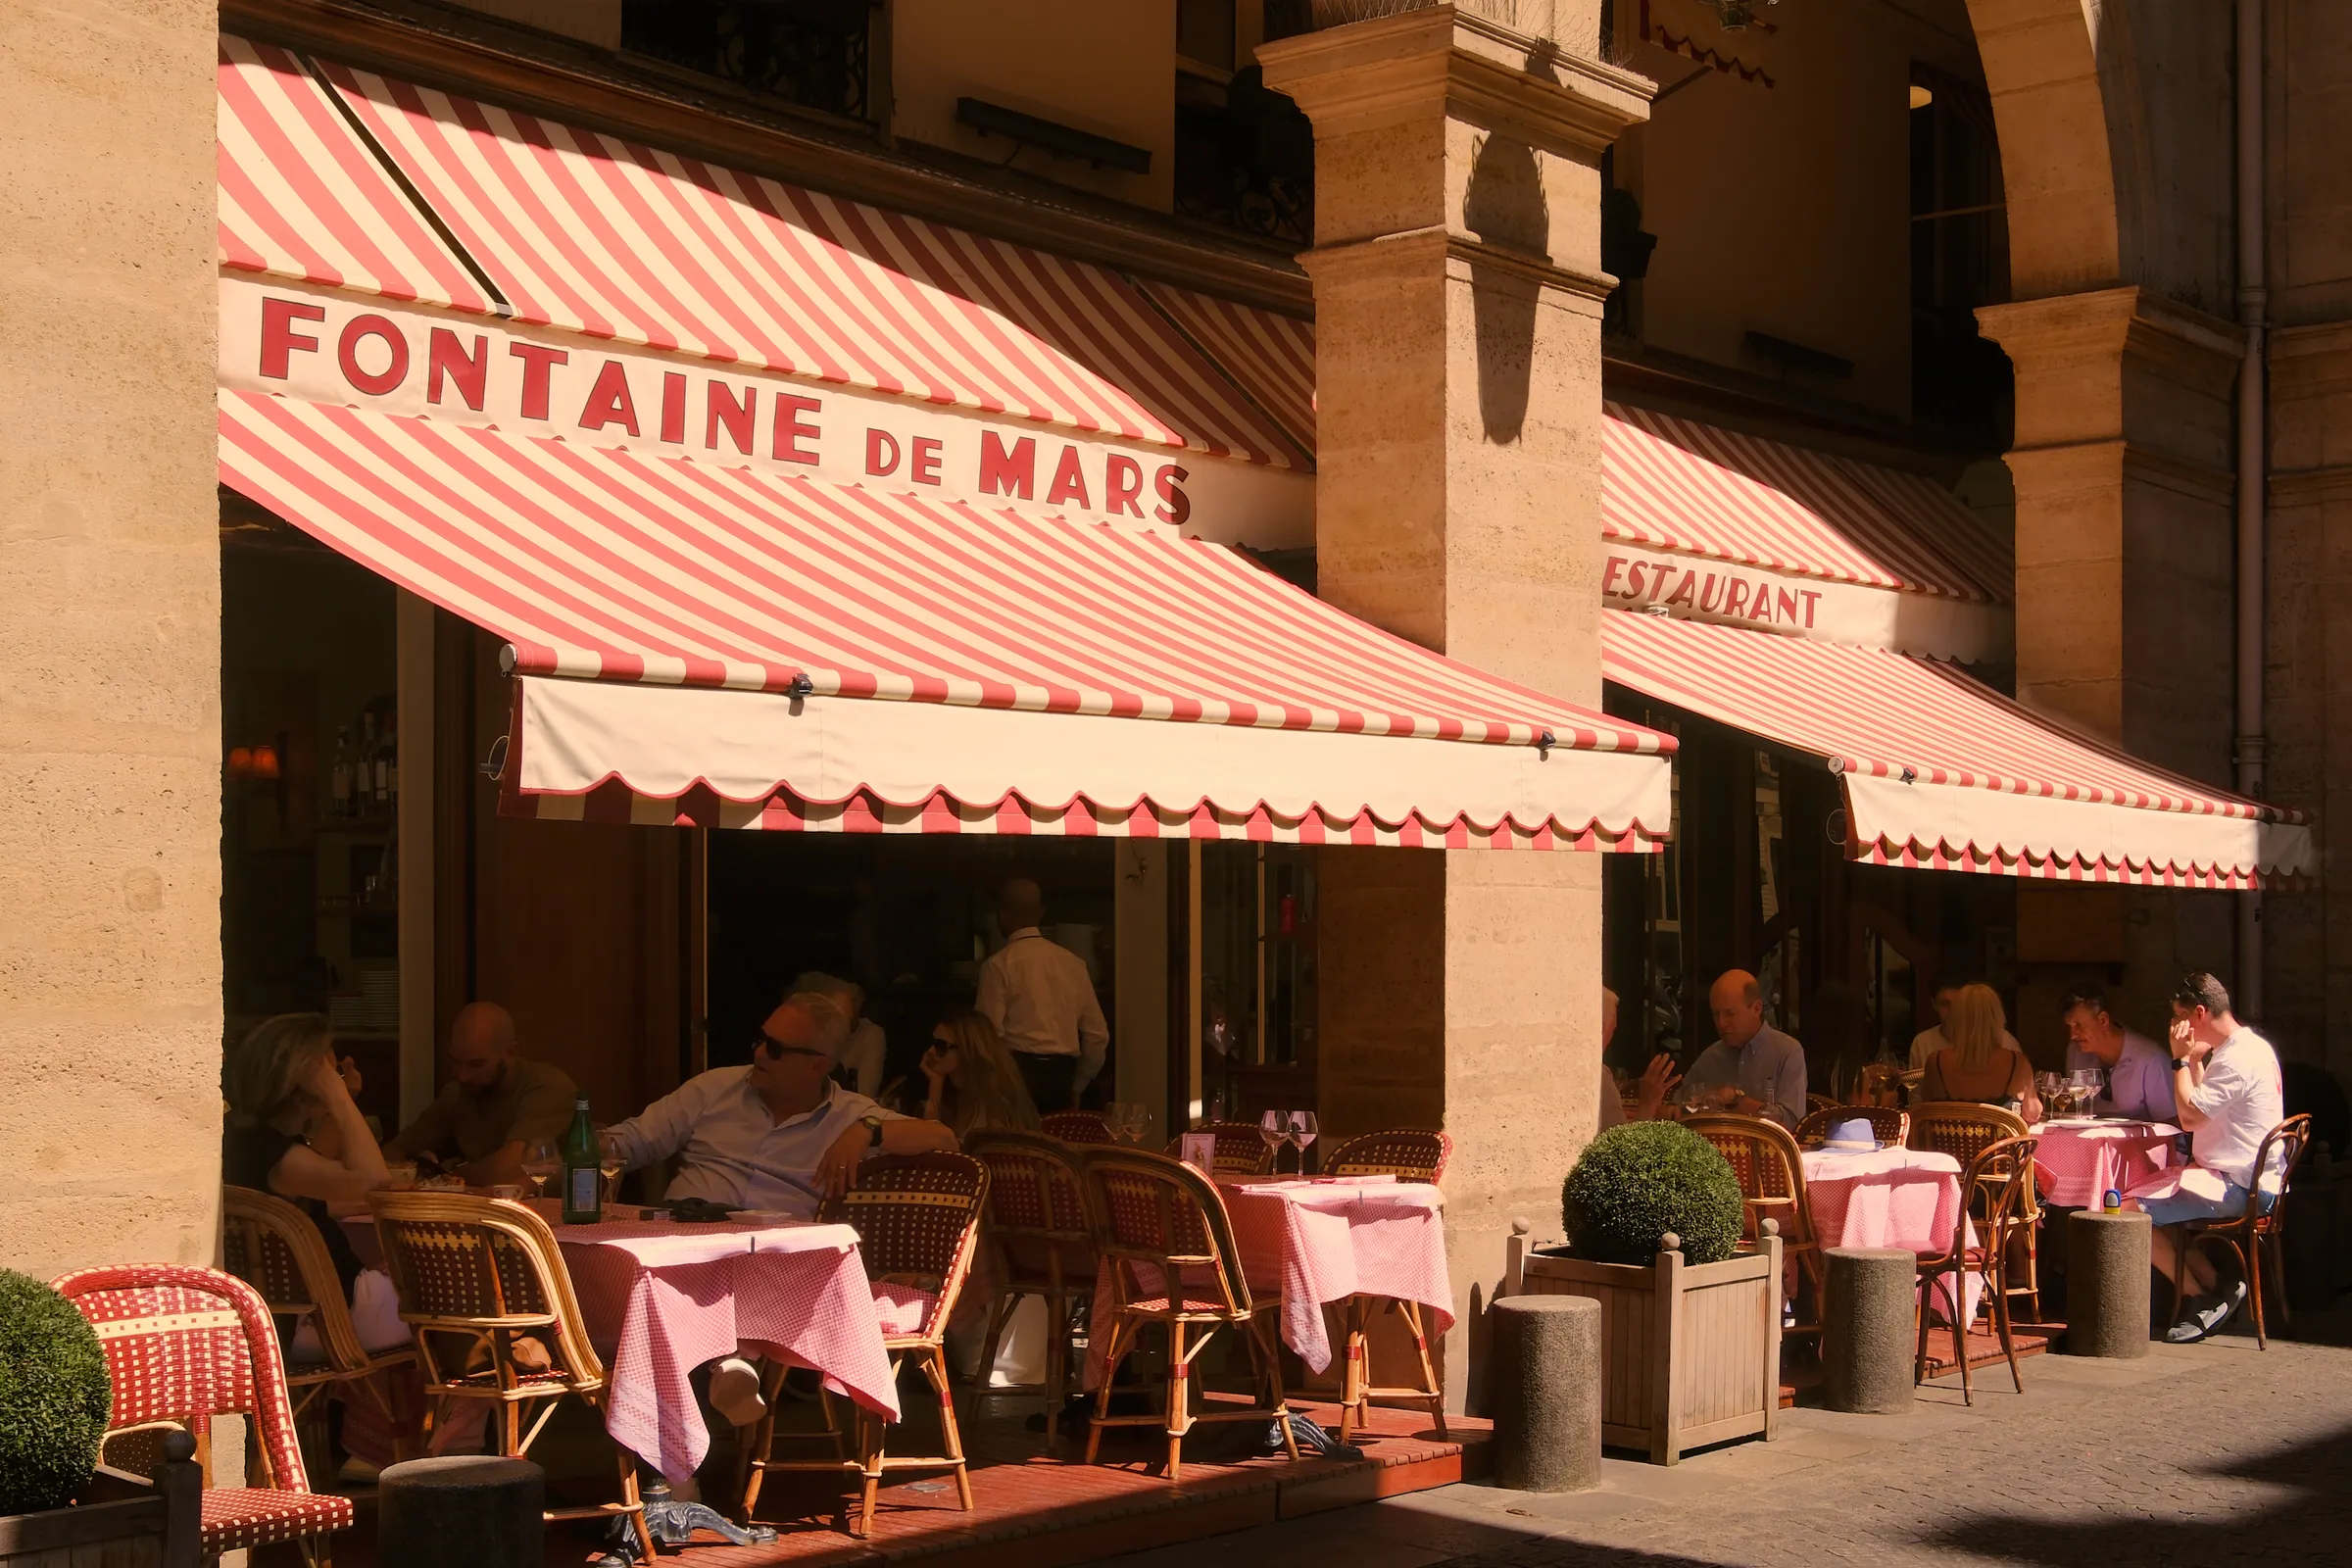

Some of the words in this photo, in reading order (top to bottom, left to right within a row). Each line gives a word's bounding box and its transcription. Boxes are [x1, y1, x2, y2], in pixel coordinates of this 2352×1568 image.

[259, 296, 822, 466] FONTAINE
[864, 427, 944, 487] DE
[978, 429, 1192, 526] MARS
[1601, 555, 1823, 629] ESTAURANT
